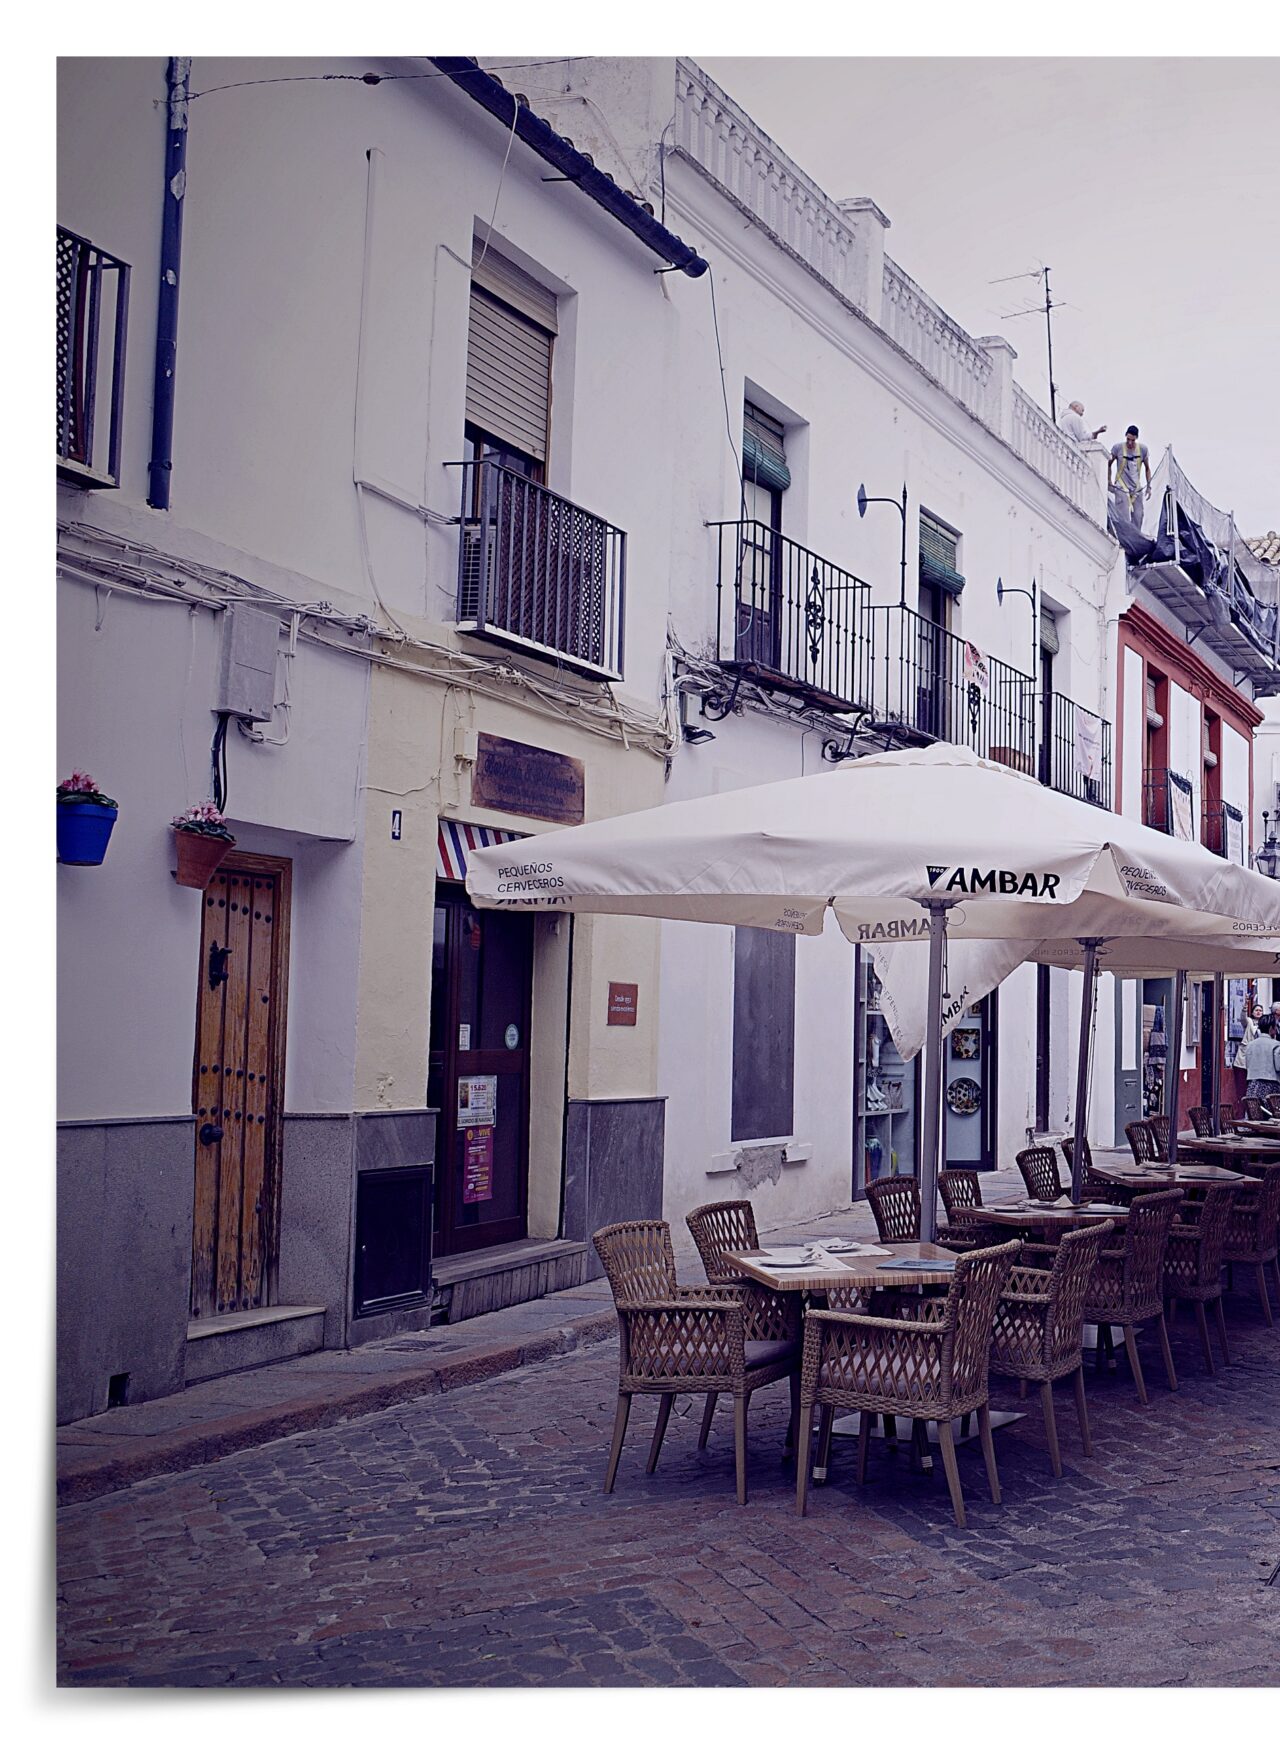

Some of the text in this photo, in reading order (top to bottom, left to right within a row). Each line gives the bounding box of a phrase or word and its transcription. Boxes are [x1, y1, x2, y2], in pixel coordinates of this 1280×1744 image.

[392, 813, 400, 836] 4
[498, 862, 553, 879] PEQUEÑOS
[497, 876, 564, 893] CERVECEROS
[946, 867, 1060, 899] AMBAR
